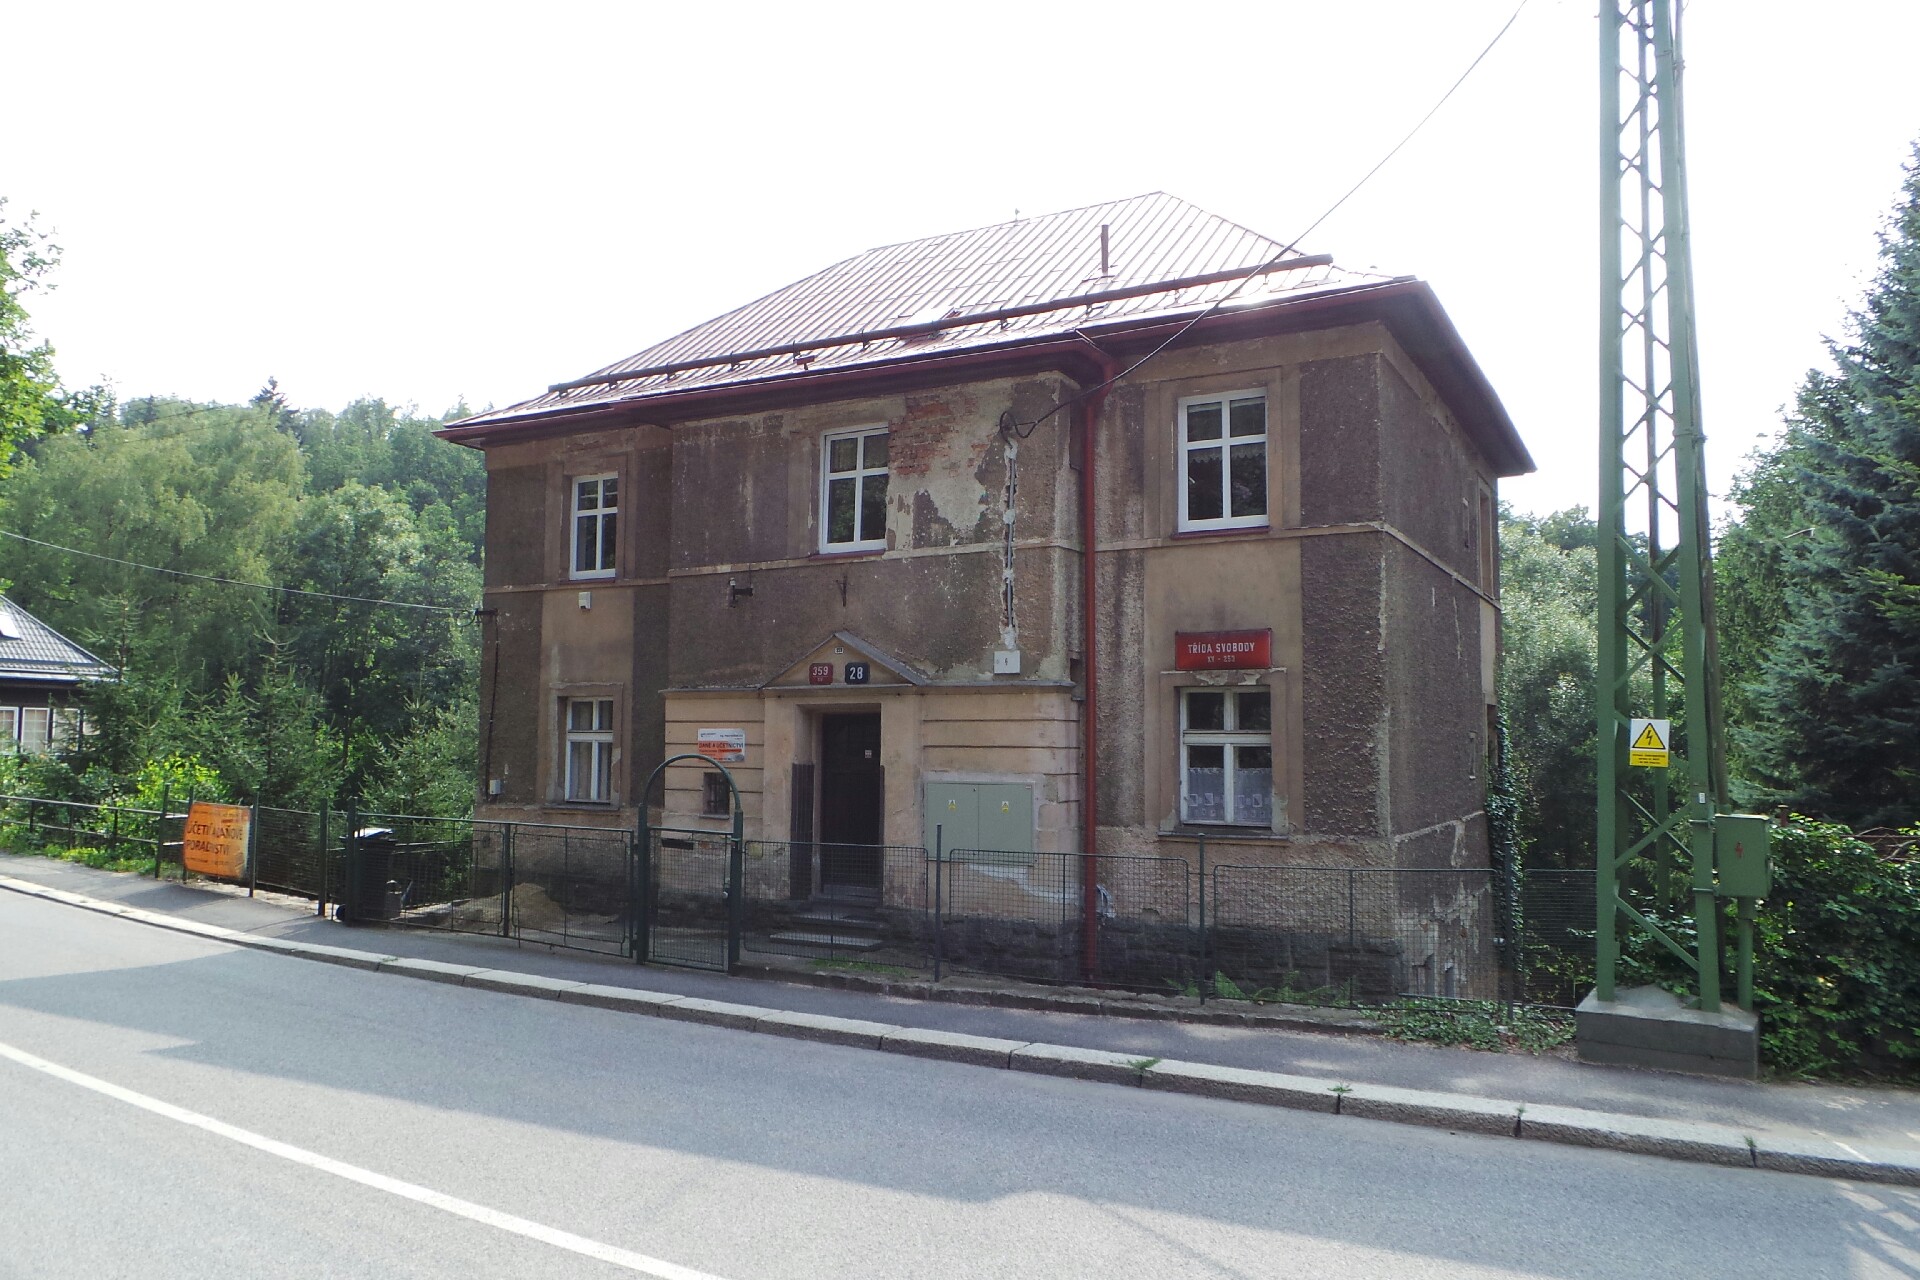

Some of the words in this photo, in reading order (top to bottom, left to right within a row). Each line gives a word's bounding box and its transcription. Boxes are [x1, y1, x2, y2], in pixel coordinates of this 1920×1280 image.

[1187, 642, 1213, 654] TŘÍDA
[1215, 642, 1255, 653] SVOBODY
[812, 666, 829, 676] 359
[849, 666, 864, 680] 28
